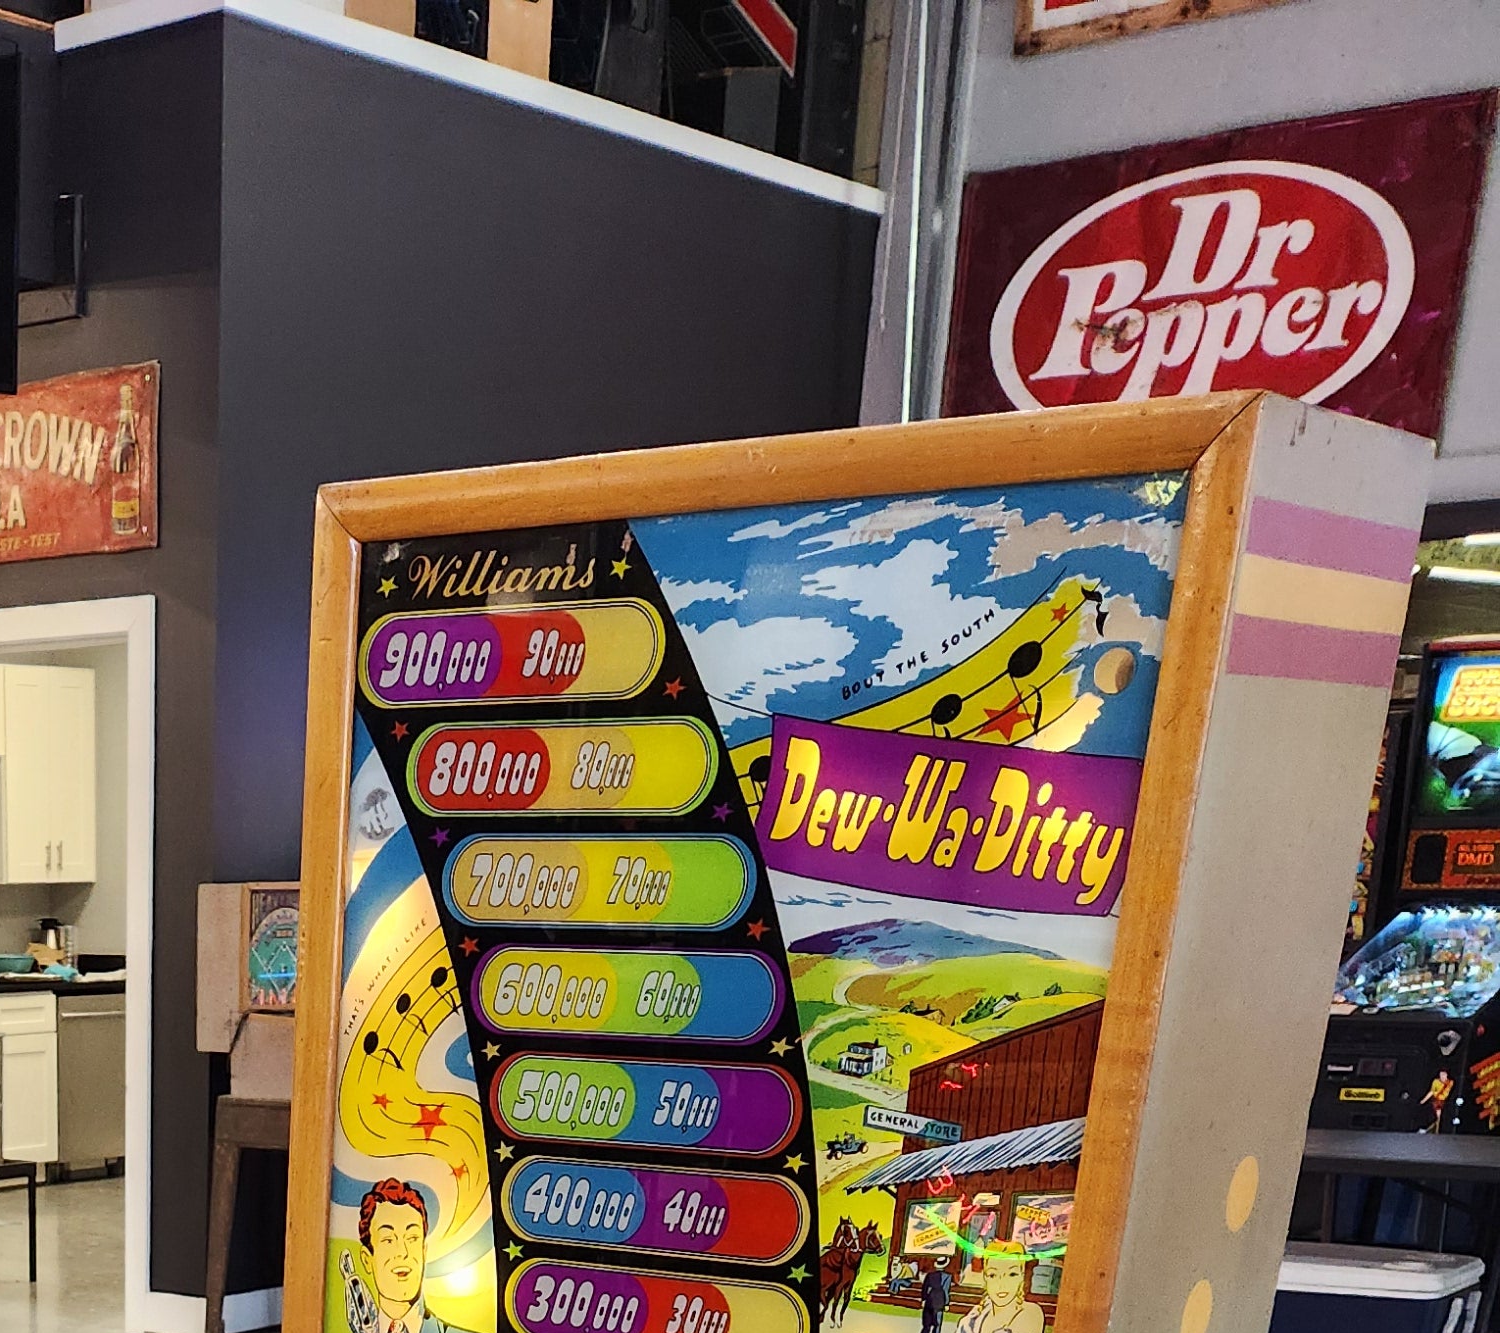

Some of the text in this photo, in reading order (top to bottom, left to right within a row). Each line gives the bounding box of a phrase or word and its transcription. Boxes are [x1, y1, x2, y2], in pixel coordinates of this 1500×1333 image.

[1144, 189, 1315, 300] Dr
[1029, 260, 1383, 400] Pepper
[407, 550, 597, 600] Williams
[379, 630, 491, 691] 900,000
[842, 608, 995, 701] BOUT THE SOUTH
[429, 741, 540, 800] 800,000
[467, 853, 579, 915] 700,000
[1458, 852, 1494, 866] DMD
[367, 956, 392, 991] WHAT
[404, 917, 426, 943] LIKE
[493, 963, 608, 1023] 600,000
[512, 1070, 626, 1130] 500,000
[870, 1111, 959, 1139] GENERAL STORE
[523, 1174, 635, 1232] 400,000
